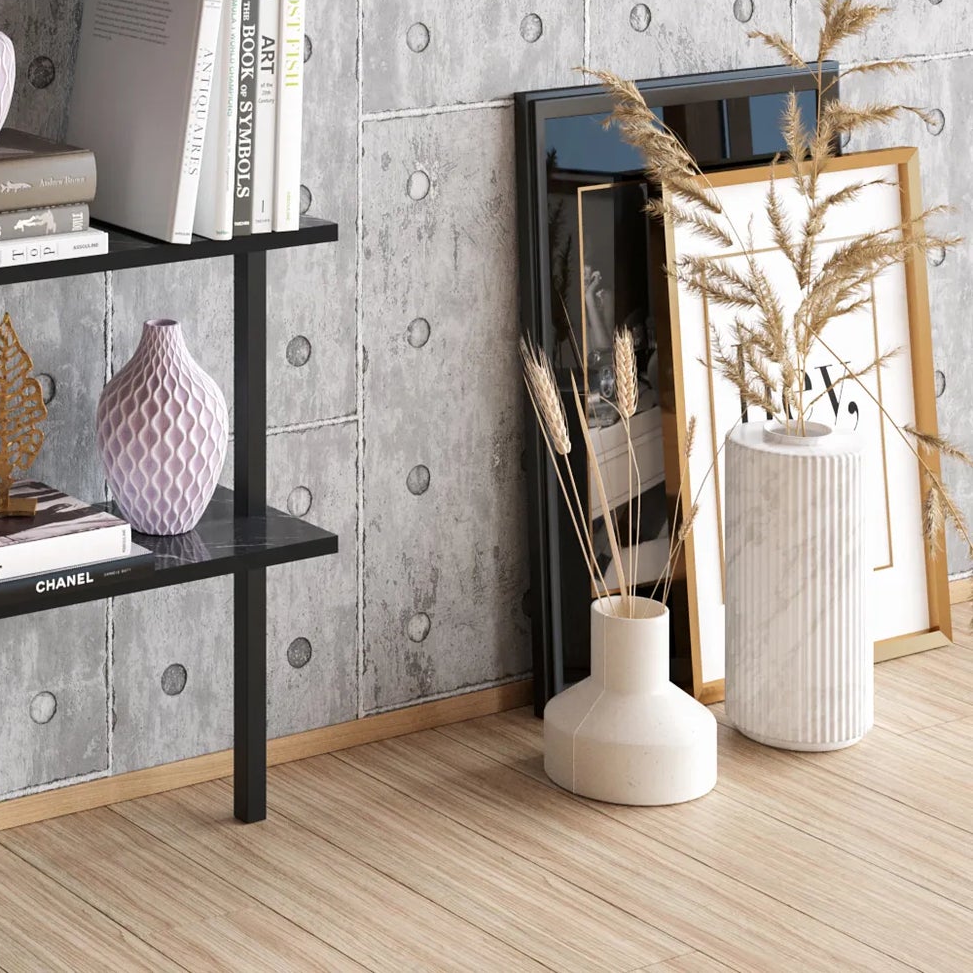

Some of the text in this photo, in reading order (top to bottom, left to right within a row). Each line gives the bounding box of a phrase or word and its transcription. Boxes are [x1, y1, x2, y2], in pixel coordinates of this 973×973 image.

[261, 35, 276, 75] ART
[285, 39, 300, 87] FISH
[188, 47, 214, 176] ANTIQUAIRES
[236, 0, 256, 199] THE BOOK OF SYMBOLS
[258, 97, 276, 105] Century
[39, 173, 87, 188] Andrew Brown
[35, 571, 95, 594] CHANEL
